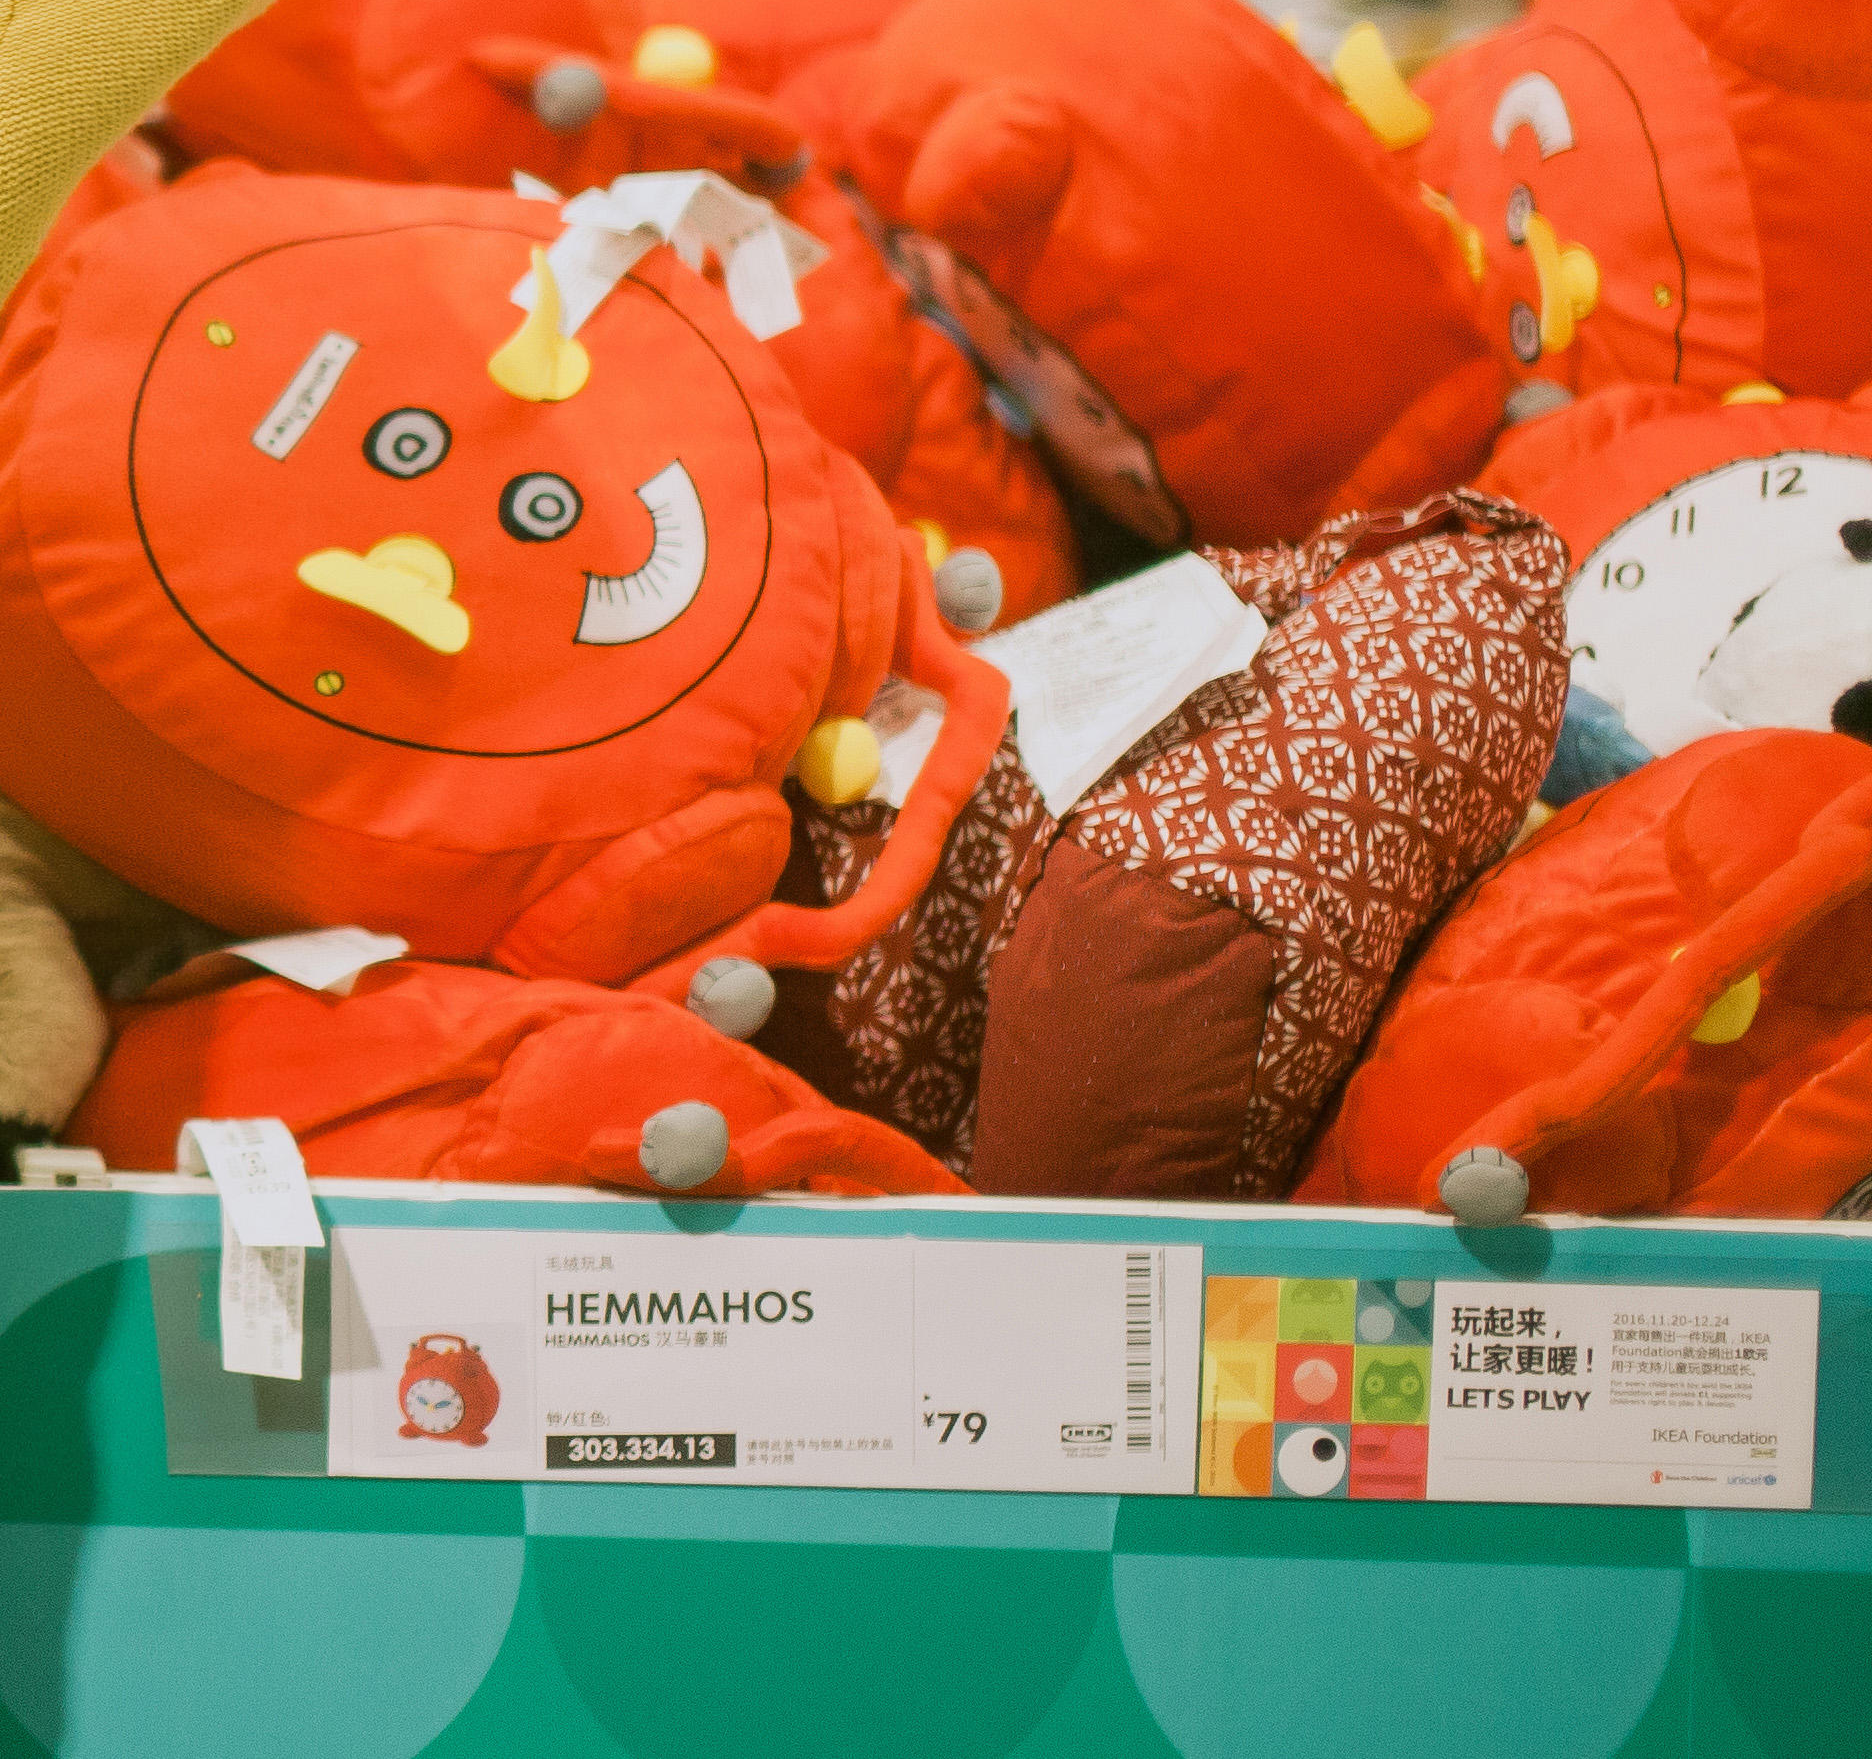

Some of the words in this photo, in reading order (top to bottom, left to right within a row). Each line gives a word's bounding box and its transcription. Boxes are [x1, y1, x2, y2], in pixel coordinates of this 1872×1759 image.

[1760, 465, 1809, 499] 12
[1671, 504, 1696, 536] 11
[1602, 560, 1646, 590] 10
[546, 1290, 815, 1325] HEMMAHOS
[1612, 1313, 1729, 1327] 2016.11.20-12.24
[544, 1331, 651, 1348] HEMMAHOS
[1447, 1387, 1515, 1410] LETS
[923, 1412, 988, 1444] ¥79
[1652, 1428, 1689, 1443] IKEA
[1694, 1430, 1778, 1445] Foundation
[568, 1437, 716, 1461] 303.334.13
